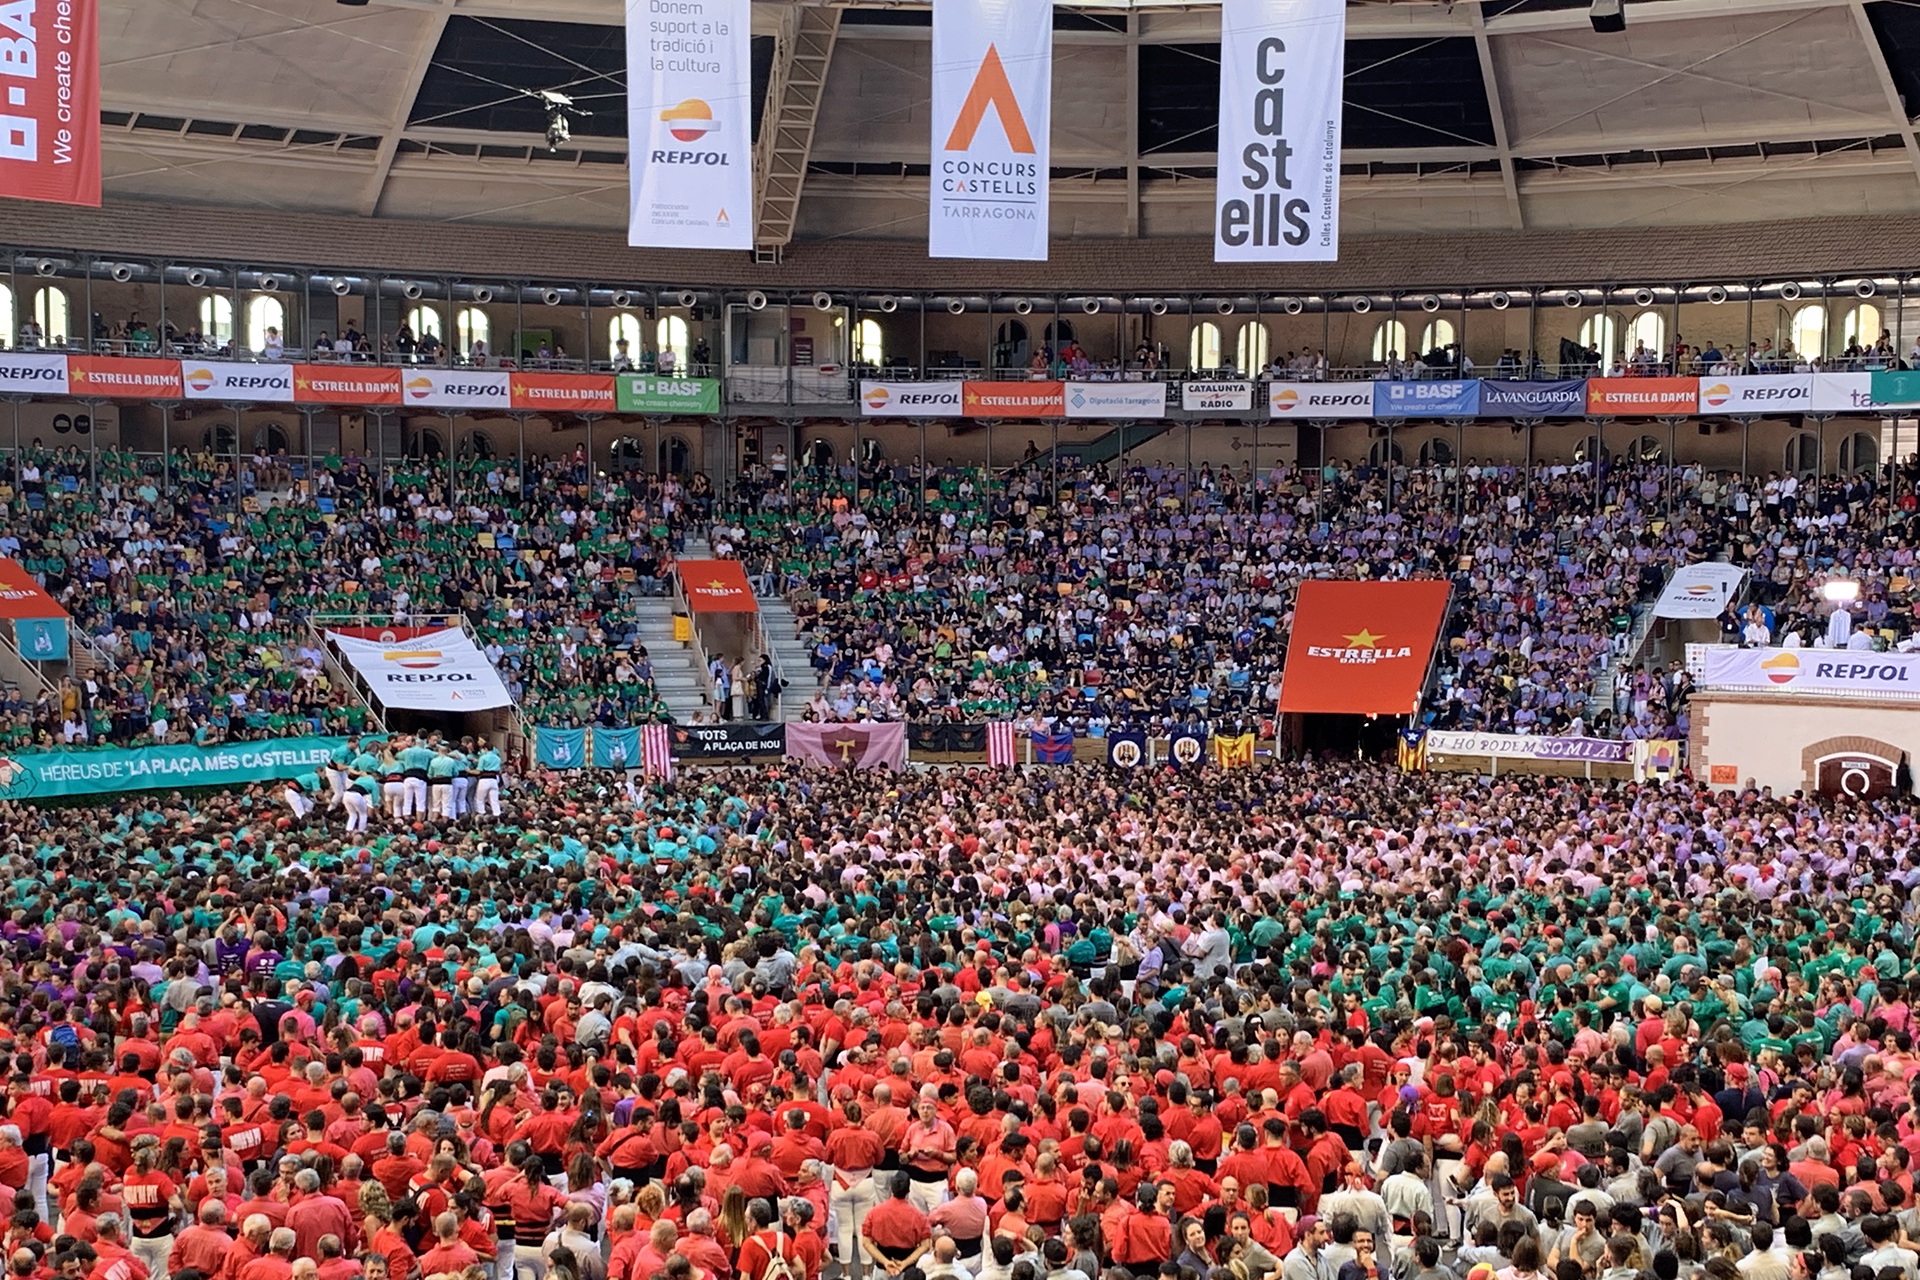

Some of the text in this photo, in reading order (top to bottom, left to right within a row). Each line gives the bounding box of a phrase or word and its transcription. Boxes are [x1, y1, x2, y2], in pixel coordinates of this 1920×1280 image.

[650, 0, 703, 15] Donem
[650, 21, 729, 36] suport a la
[651, 39, 714, 54] tradició i
[651, 57, 721, 73] la cultura
[53, 0, 72, 164] We create che
[651, 150, 730, 166] REPSOL
[943, 161, 1037, 177] CONCURS
[943, 179, 1037, 195] CASTELLS
[1321, 120, 1336, 247] Colles Castelleres de Catalunya
[943, 206, 1036, 220] TARRAGONA
[0, 367, 65, 381] REPSOL
[89, 372, 179, 387] ESTRELLA DAMM
[226, 376, 291, 389] REPSOL
[312, 381, 399, 394] ESTRELLA DAMM
[657, 381, 702, 396] BASF
[1189, 385, 1246, 393] CATALUNYA
[444, 384, 508, 397] REPSOL
[529, 388, 613, 400] ESTRELLA DAMM
[1416, 384, 1463, 399] BASF
[1742, 386, 1810, 401] REPSOL
[633, 399, 645, 407] We
[669, 400, 702, 409] chemistry
[900, 394, 960, 405] REPSOL
[981, 395, 1063, 406] ESTRELLA DAMM
[1089, 397, 1160, 406] Diputació Tarragona
[1309, 395, 1371, 406] REPSOL
[1606, 392, 1696, 405] ESTRELLA DAMM
[1427, 403, 1463, 413] chemistry
[1307, 646, 1412, 659] ESTRELLA
[387, 674, 478, 683] REPSOL
[1816, 663, 1909, 681] REPSOL
[697, 730, 728, 741] TOTS
[704, 740, 781, 752] A PLAÇA DE NOU
[1428, 736, 1622, 760] SI HO PODEM SOMIAR
[41, 762, 101, 782] HEREUS
[102, 762, 123, 778] DE
[152, 757, 201, 778] PLAÇA
[205, 751, 240, 771] MÉS
[242, 749, 337, 769] CASTELLER
